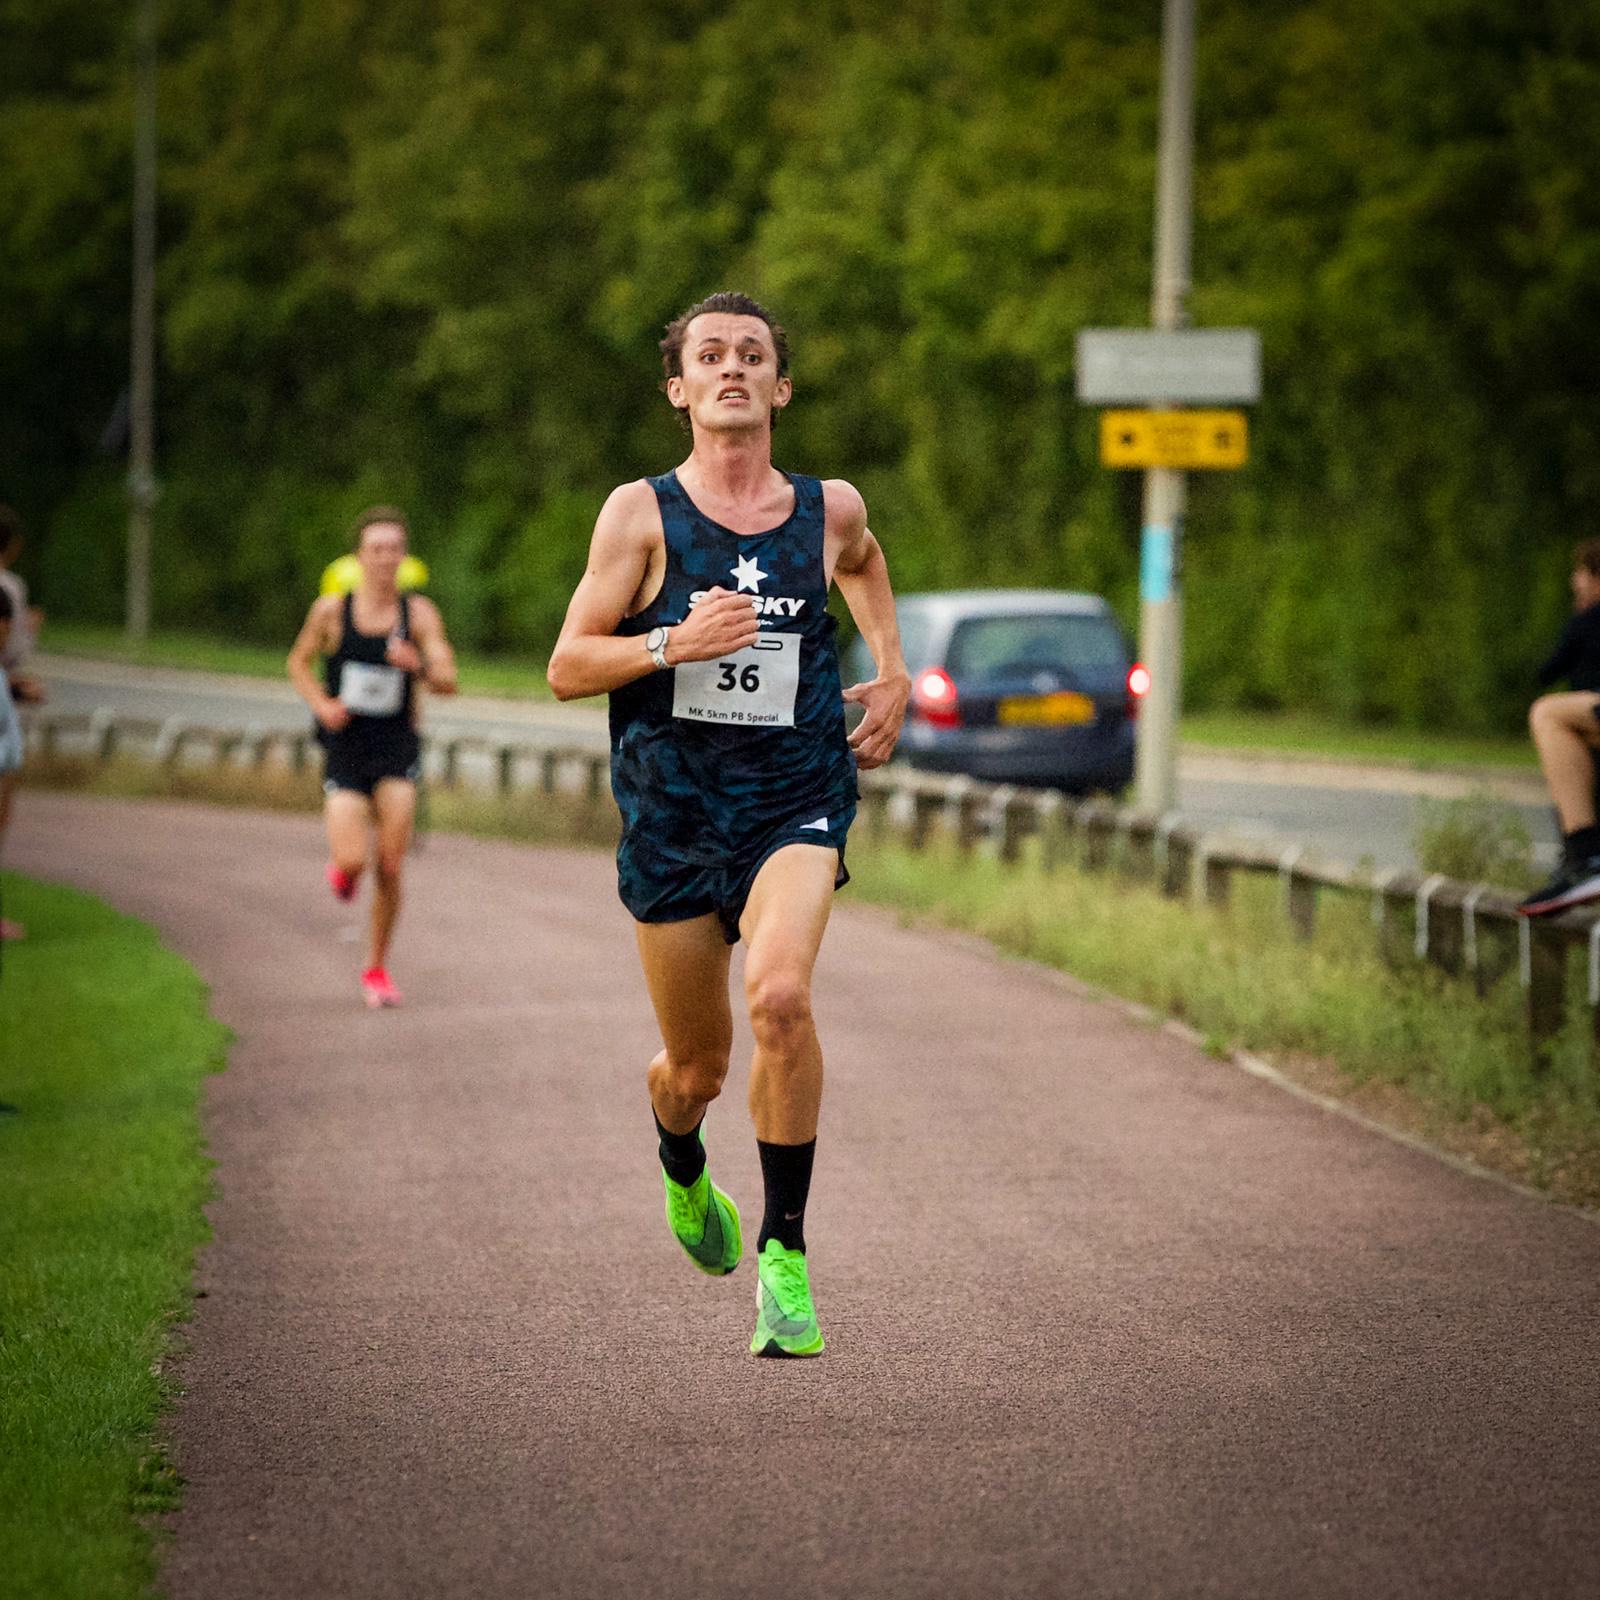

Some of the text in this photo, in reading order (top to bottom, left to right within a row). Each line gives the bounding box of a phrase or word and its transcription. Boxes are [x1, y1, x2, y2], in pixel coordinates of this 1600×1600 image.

[688, 590, 806, 617] SSKY
[716, 662, 760, 693] 36
[688, 706, 779, 723] MK 5km PB Special
